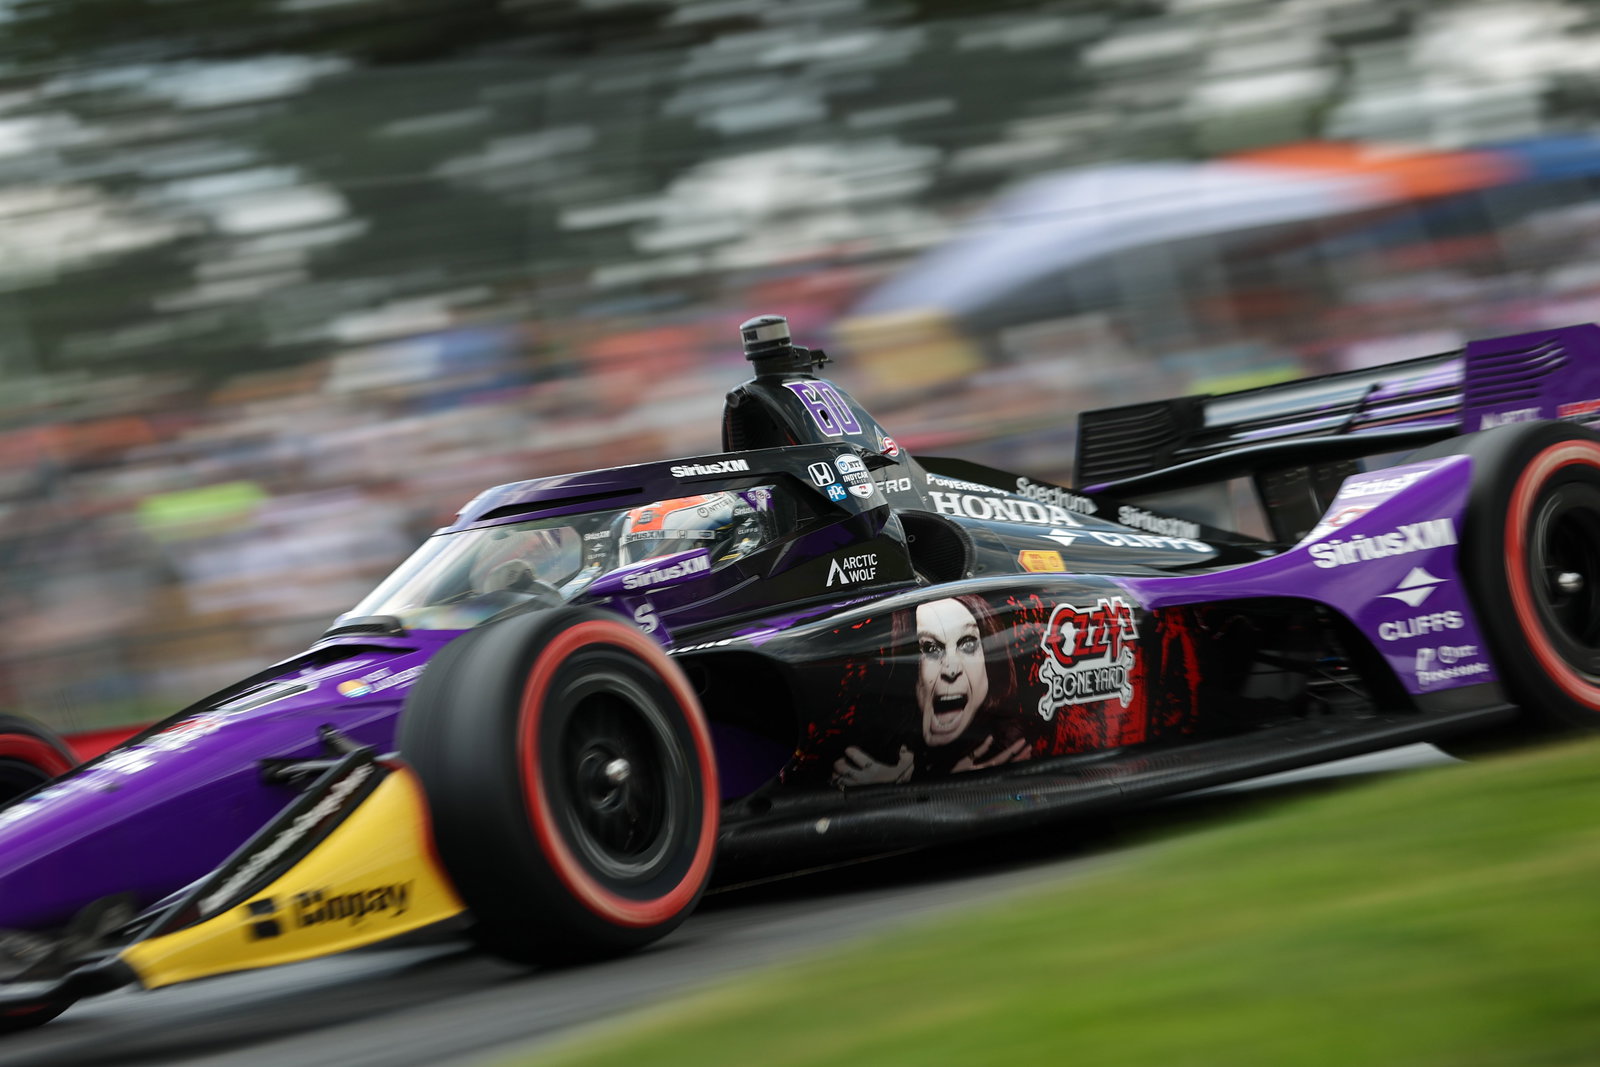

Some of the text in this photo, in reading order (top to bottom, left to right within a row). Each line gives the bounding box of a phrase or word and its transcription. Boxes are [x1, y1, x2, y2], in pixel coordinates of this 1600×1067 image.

[782, 381, 862, 437] 60
[670, 459, 750, 478] SiriusXM
[843, 471, 869, 483] INDYCAR
[928, 491, 1084, 527] HONDA
[1118, 505, 1200, 539] SiriusXM
[1308, 517, 1458, 569] SiriusXM
[621, 554, 711, 590] SiriusXM
[843, 553, 878, 570] ARCTIC
[848, 567, 877, 583] WOLF
[1378, 610, 1465, 641] CLIFFS
[1052, 666, 1127, 699] BONEYARD
